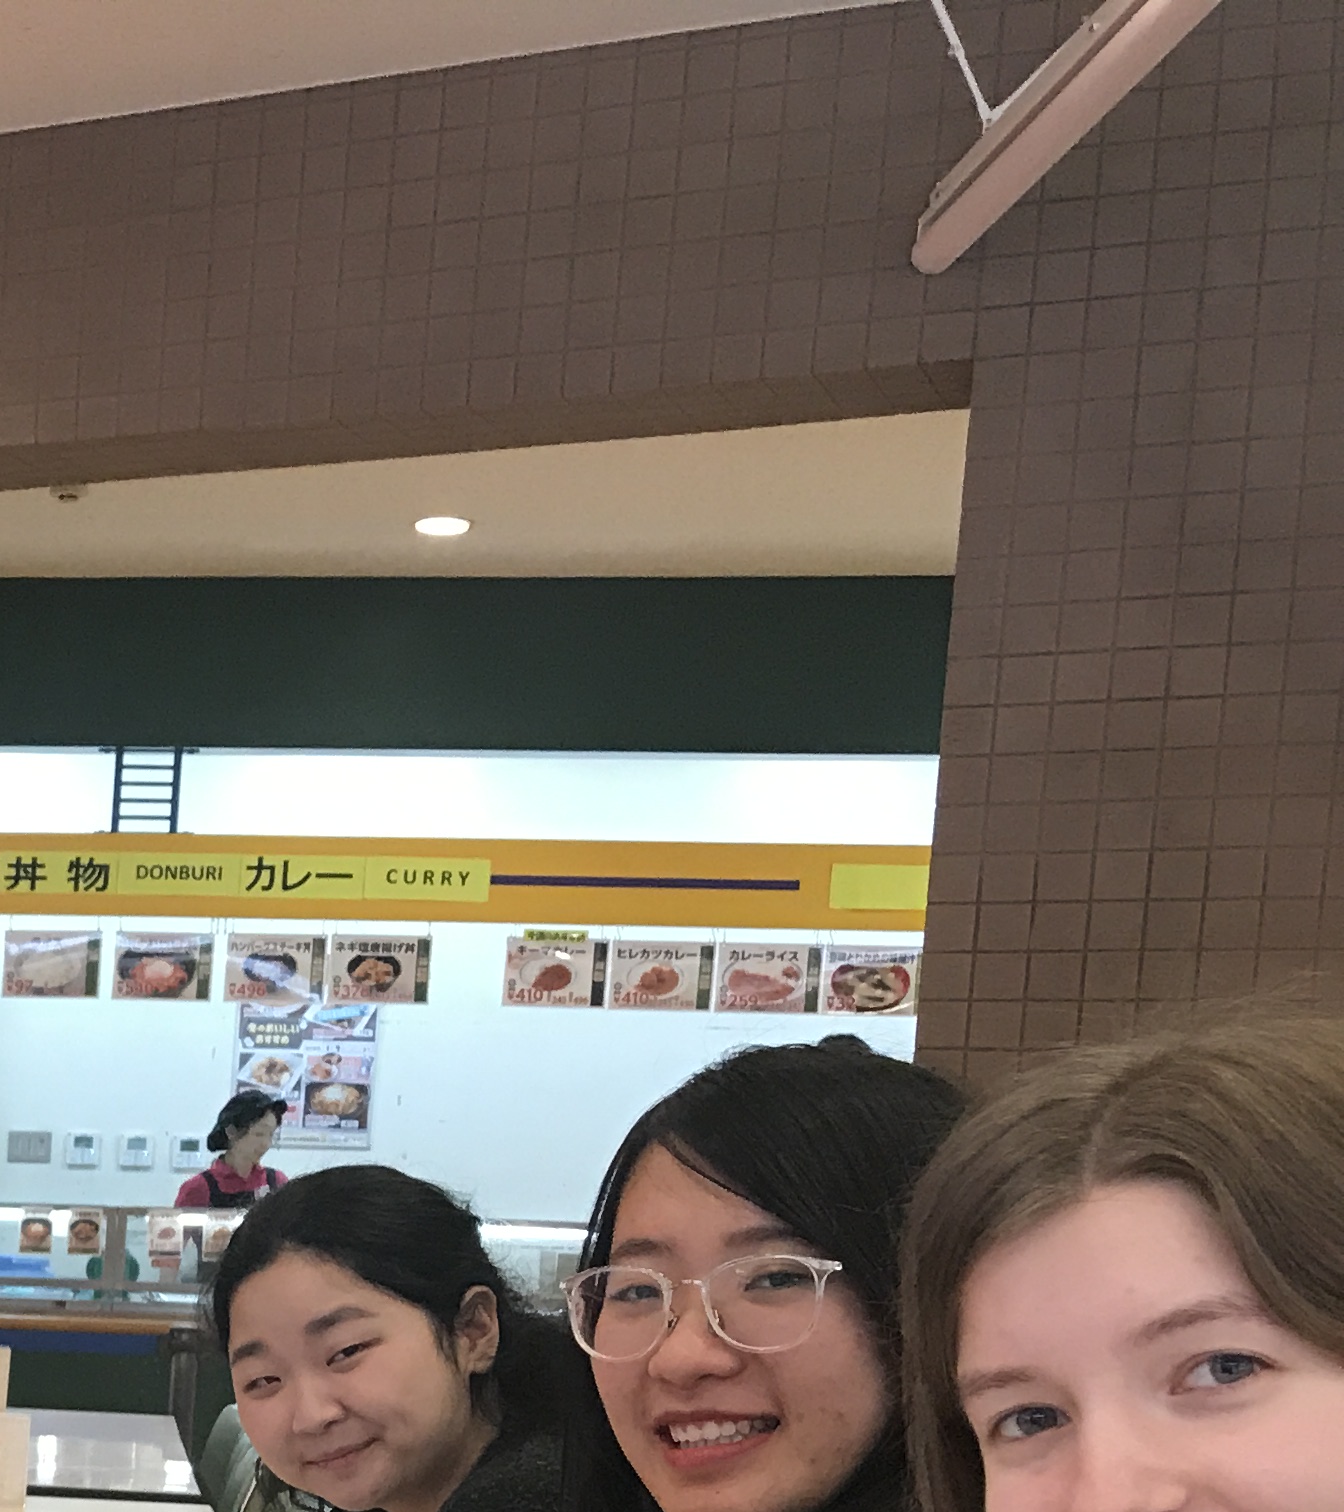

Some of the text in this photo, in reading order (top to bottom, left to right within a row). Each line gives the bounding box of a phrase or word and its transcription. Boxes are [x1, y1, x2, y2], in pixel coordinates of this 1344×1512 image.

[135, 864, 223, 882] DONBURI
[246, 856, 354, 892] カレー
[385, 868, 471, 887] CURRY
[617, 947, 698, 960] ヒレカツカレー
[729, 950, 799, 962] カレーライス
